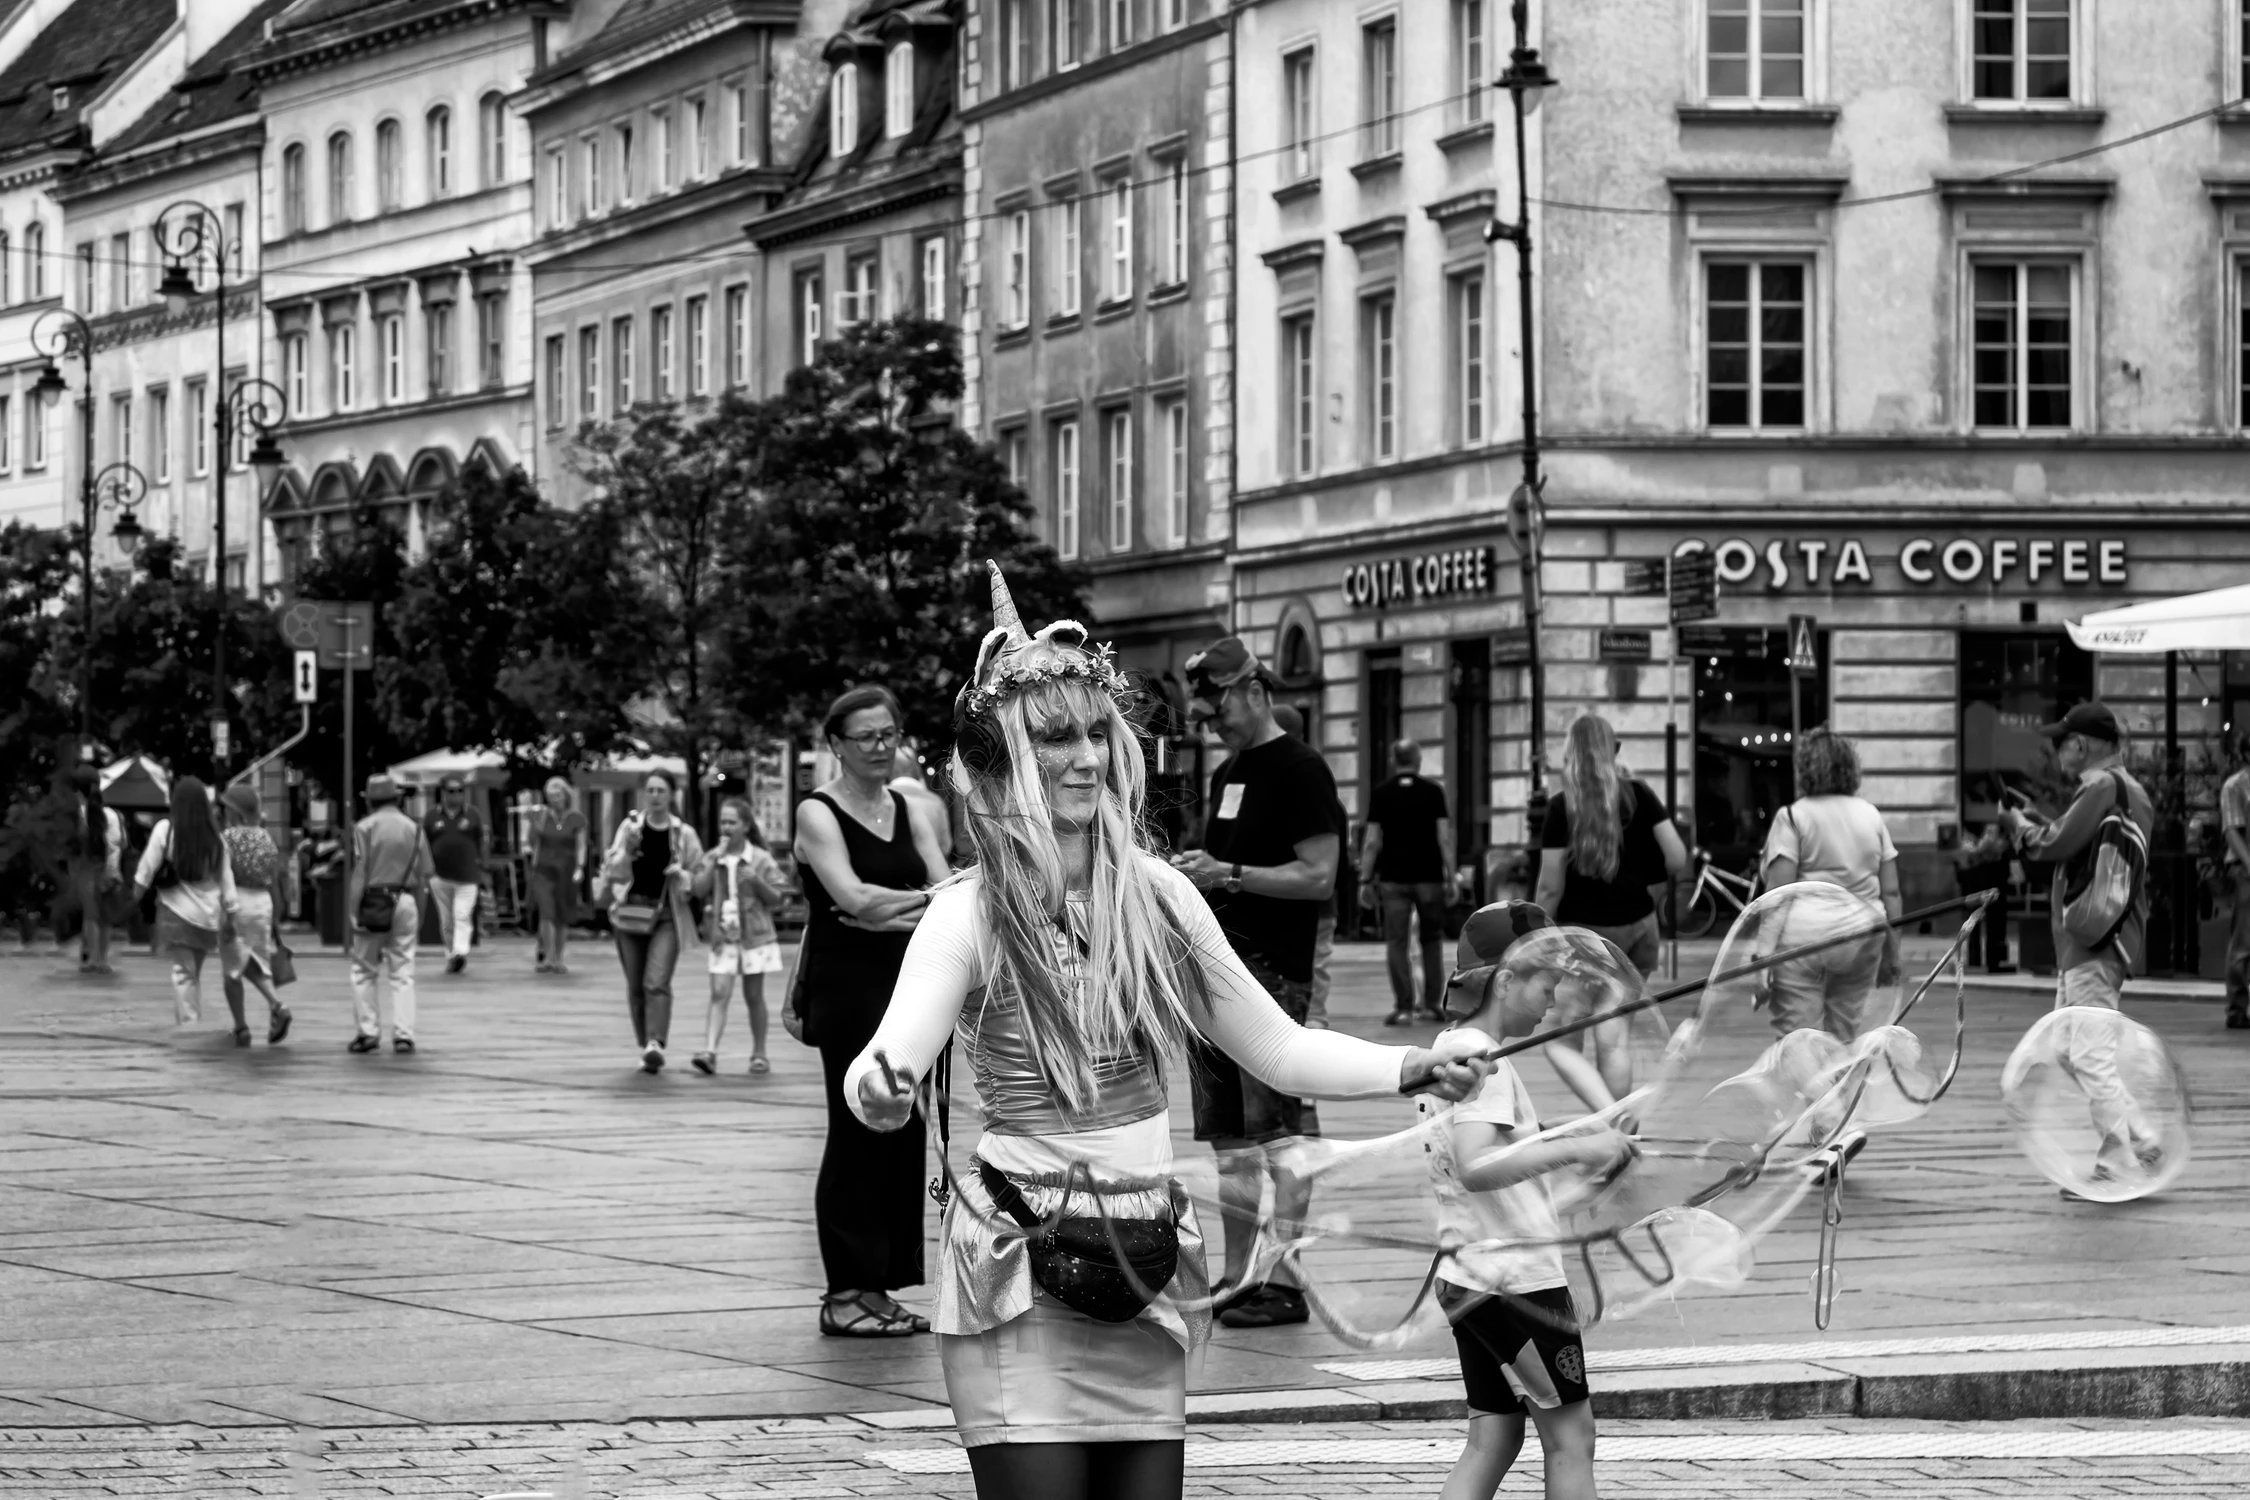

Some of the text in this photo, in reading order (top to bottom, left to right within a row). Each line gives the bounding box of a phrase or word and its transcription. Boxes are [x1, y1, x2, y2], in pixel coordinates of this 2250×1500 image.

[1341, 547, 1487, 606] COSTA COFFEE
[1900, 539, 2127, 582] COFFEE
